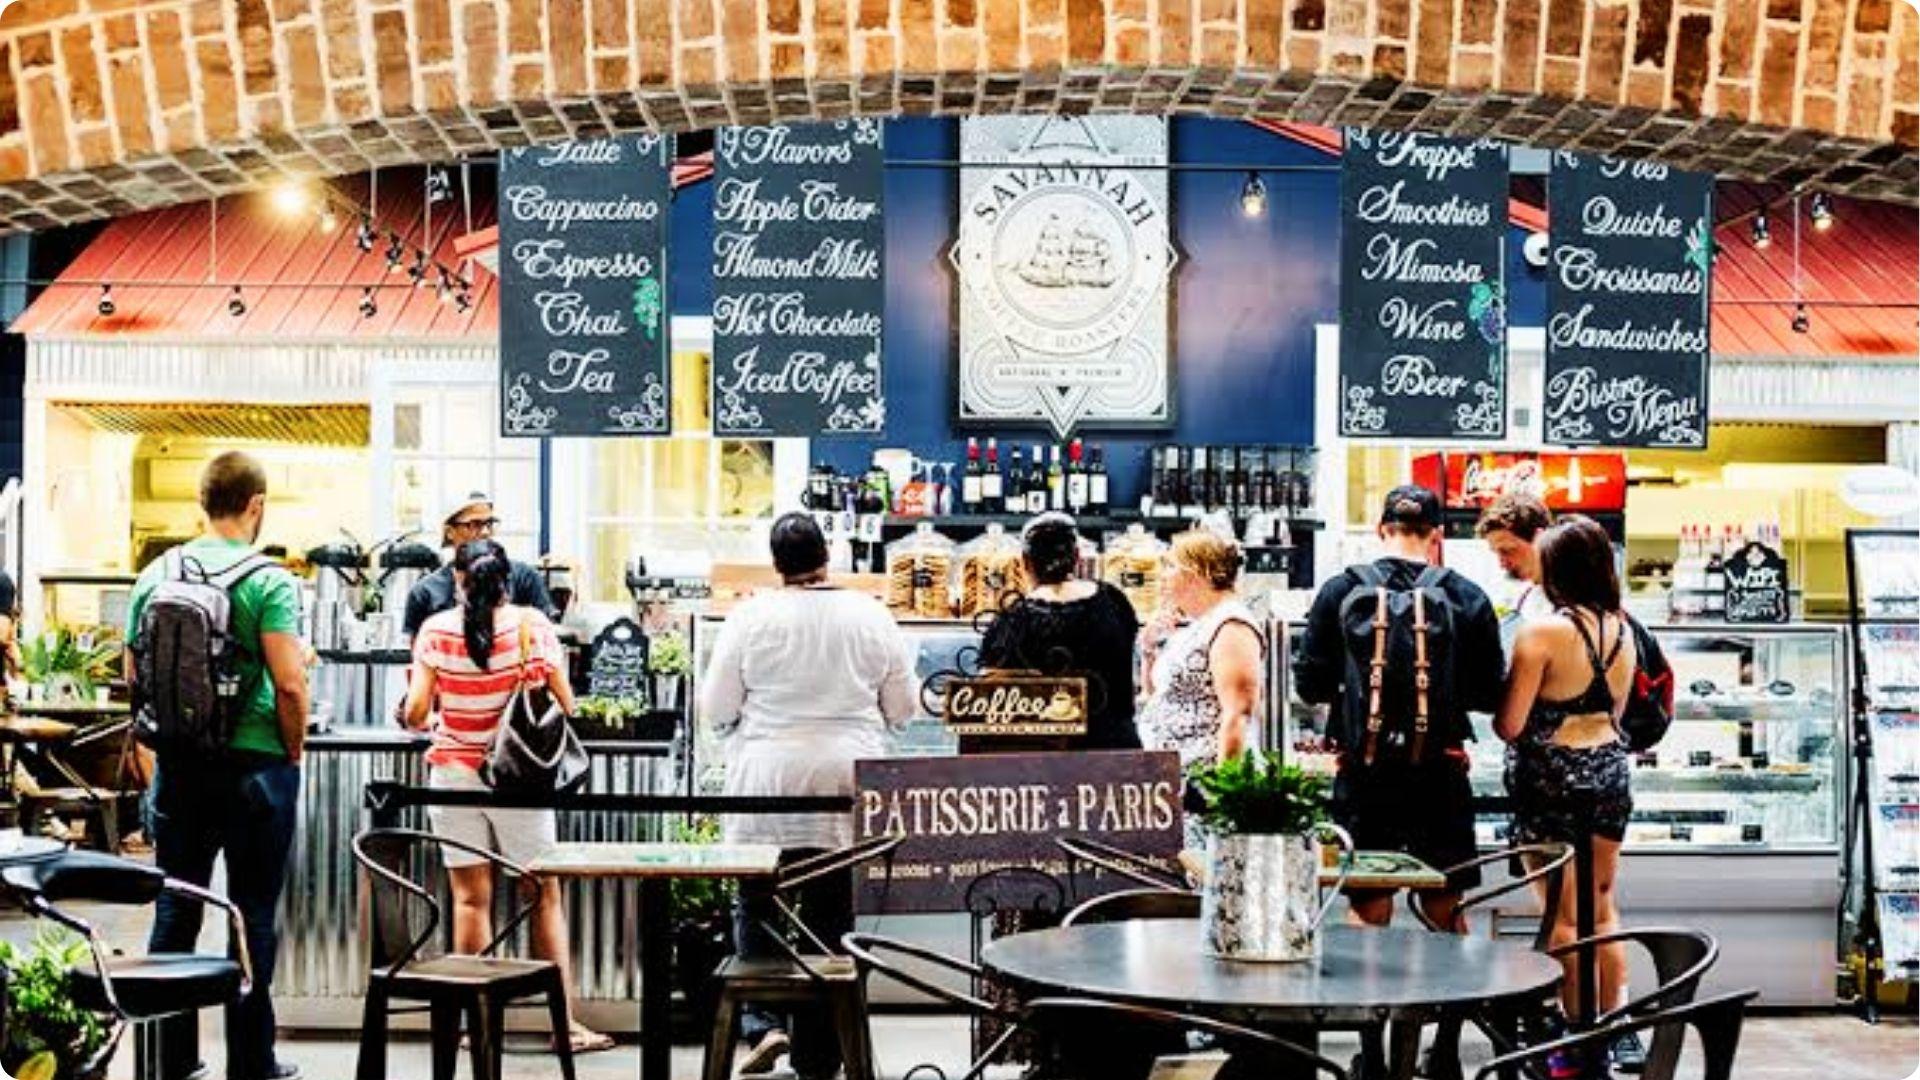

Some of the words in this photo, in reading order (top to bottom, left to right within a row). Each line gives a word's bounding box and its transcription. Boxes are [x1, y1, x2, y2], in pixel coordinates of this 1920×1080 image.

[741, 125, 852, 164] Flavors
[506, 185, 659, 232] Cappuccino
[713, 177, 799, 231] Apple
[800, 179, 878, 222] Cider
[974, 159, 1154, 226] SAVANNAH
[1358, 180, 1490, 227] Smoothies
[1582, 196, 1682, 238] Quiche
[512, 239, 652, 287] Espresso
[713, 231, 813, 279] Almond
[814, 236, 880, 280] Milk
[1361, 233, 1483, 283] Mimosa
[1555, 246, 1701, 294] Croissants
[534, 290, 628, 337] Chai
[713, 293, 768, 336] Hot
[768, 291, 881, 337] Chocolate
[1379, 297, 1465, 340] Wine
[1549, 303, 1707, 353] Sandwiches
[539, 349, 615, 393] Tea
[717, 345, 790, 393] Iced
[789, 352, 874, 403] Coffee
[1381, 355, 1466, 398] Beer
[1547, 367, 1652, 419] Bistro
[1608, 388, 1698, 440] Menu
[951, 686, 1046, 724] Coffee
[862, 785, 1049, 838] PATISSERIE
[1078, 782, 1174, 832] PARIS
